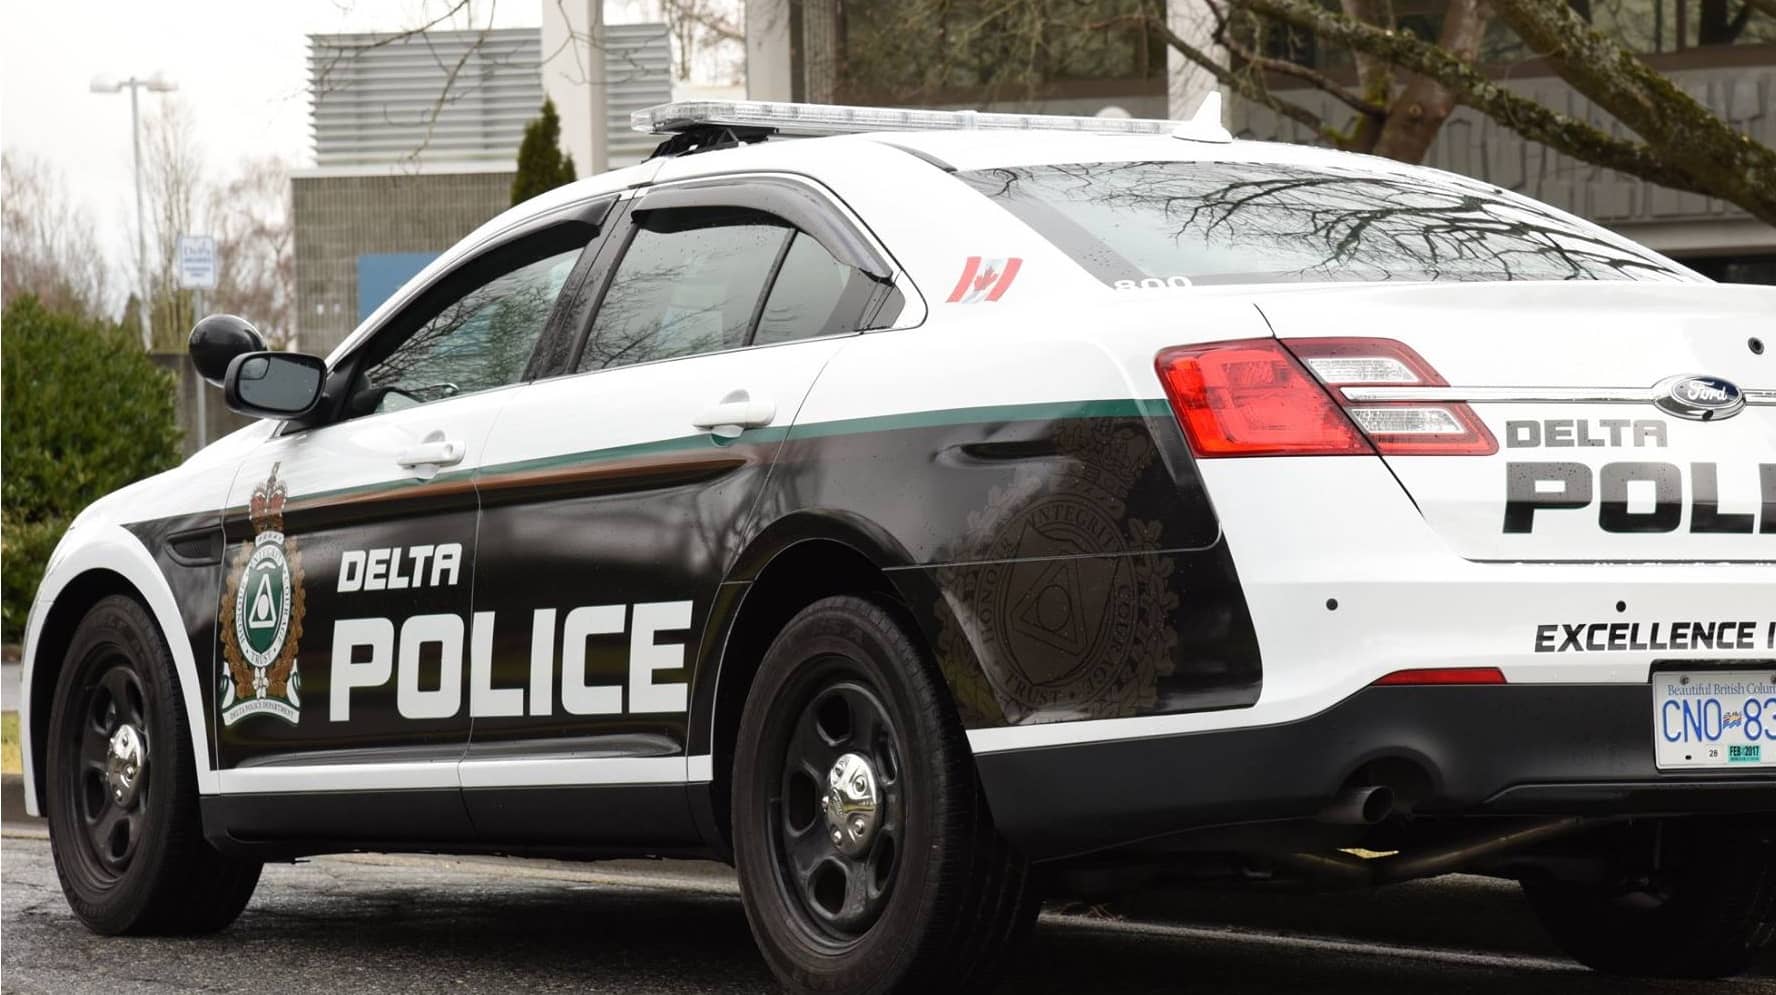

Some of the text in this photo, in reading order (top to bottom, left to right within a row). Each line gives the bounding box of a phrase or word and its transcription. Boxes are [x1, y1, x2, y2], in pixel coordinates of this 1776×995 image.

[1688, 380, 1729, 401] Ford
[1506, 419, 1669, 448] DELTA
[337, 543, 462, 592] DELTA
[1534, 621, 1757, 653] EXCELLENCE
[329, 600, 694, 723] POLICE
[1667, 683, 1711, 696] Beautiful
[1714, 683, 1744, 696] British
[1729, 745, 1760, 757] FEB 2017
